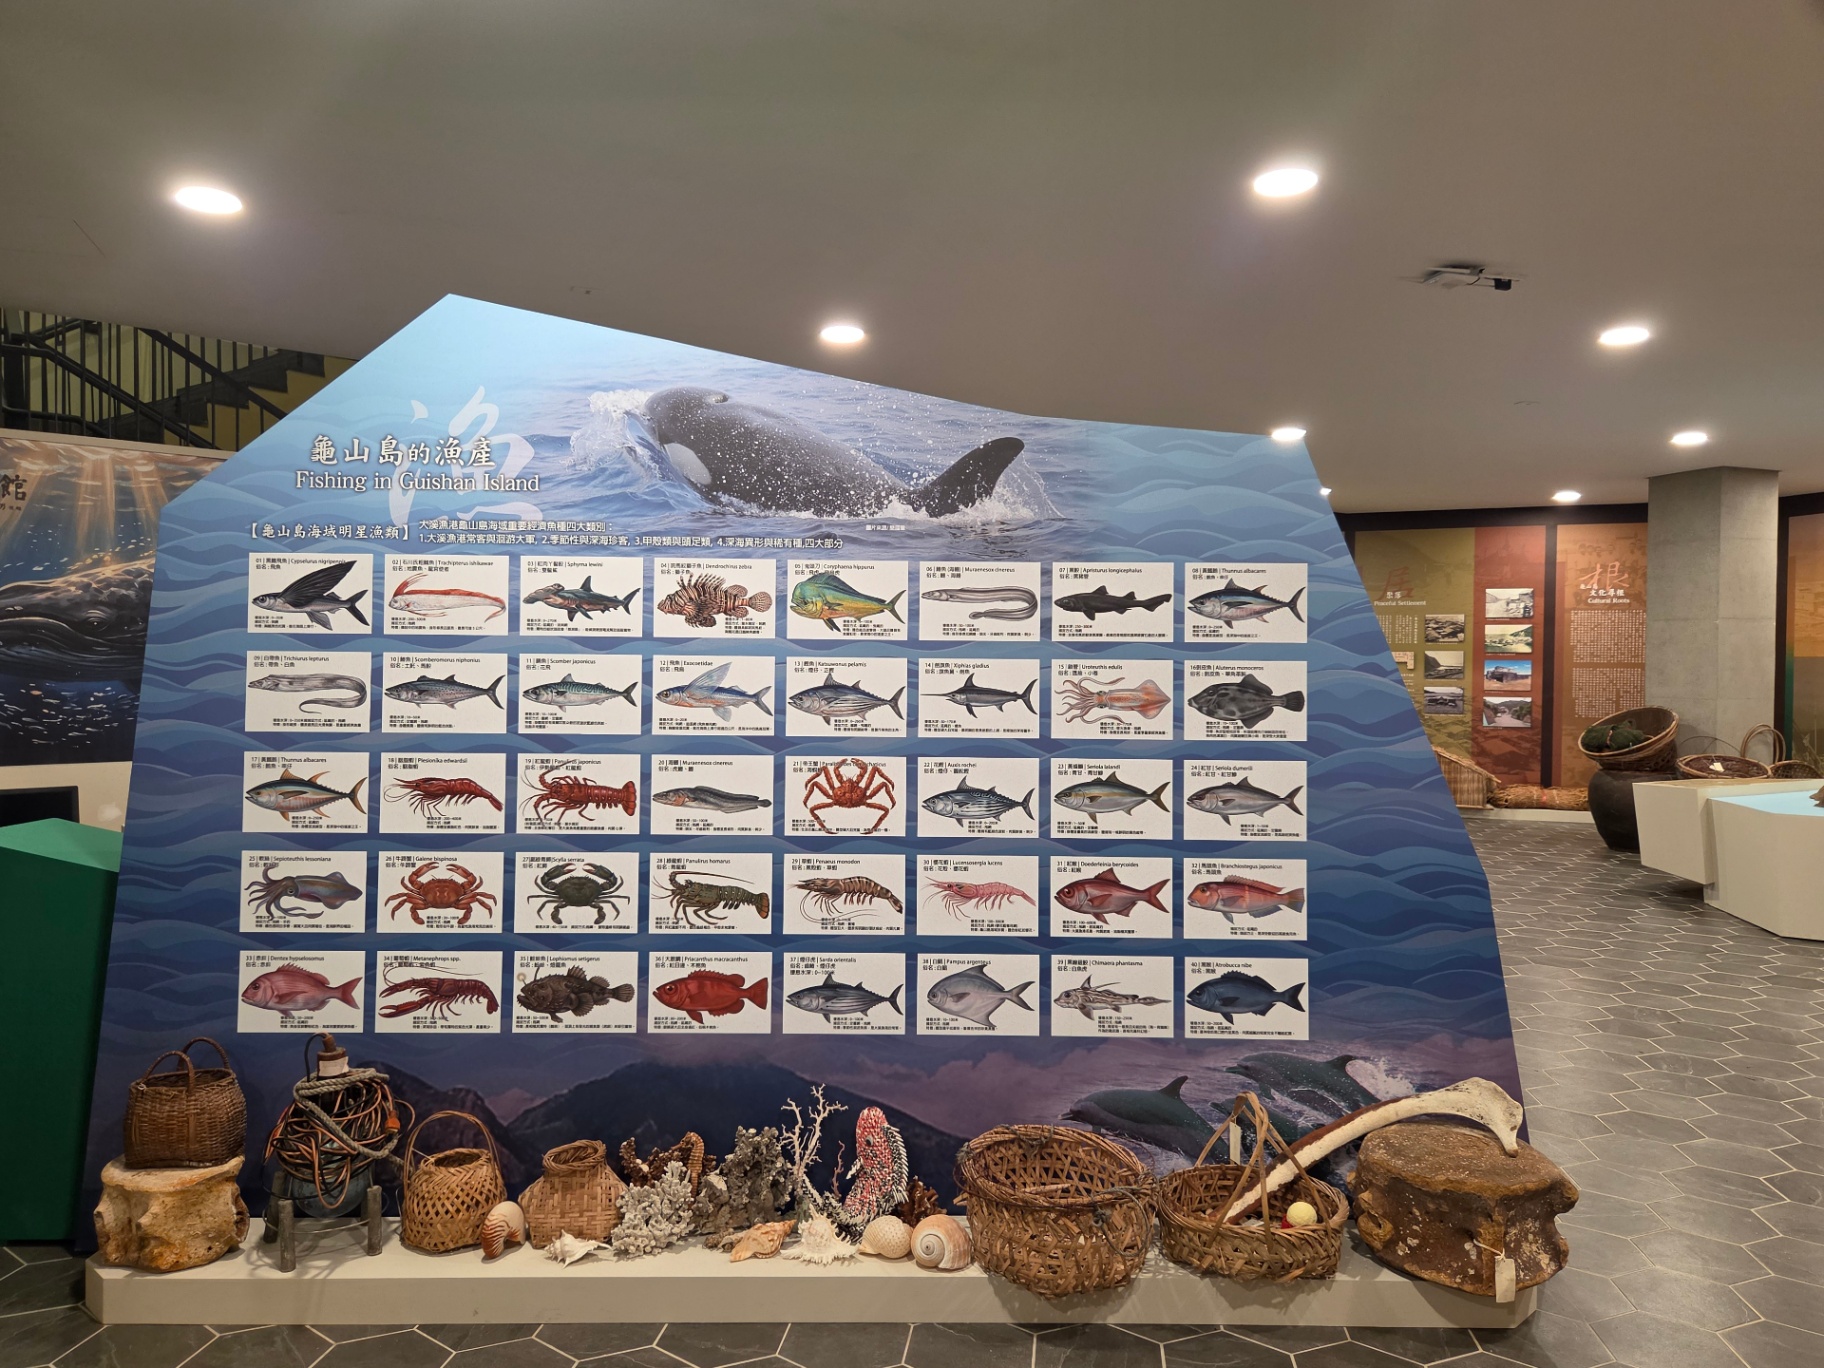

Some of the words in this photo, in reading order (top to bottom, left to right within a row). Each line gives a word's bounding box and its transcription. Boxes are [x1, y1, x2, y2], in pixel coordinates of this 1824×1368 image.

[311, 434, 495, 466] 龜山島的漁產
[296, 470, 367, 492] Fishing
[374, 472, 391, 489] in
[399, 472, 476, 491] Guishan
[484, 473, 539, 491] Island
[1578, 561, 1630, 590] 根
